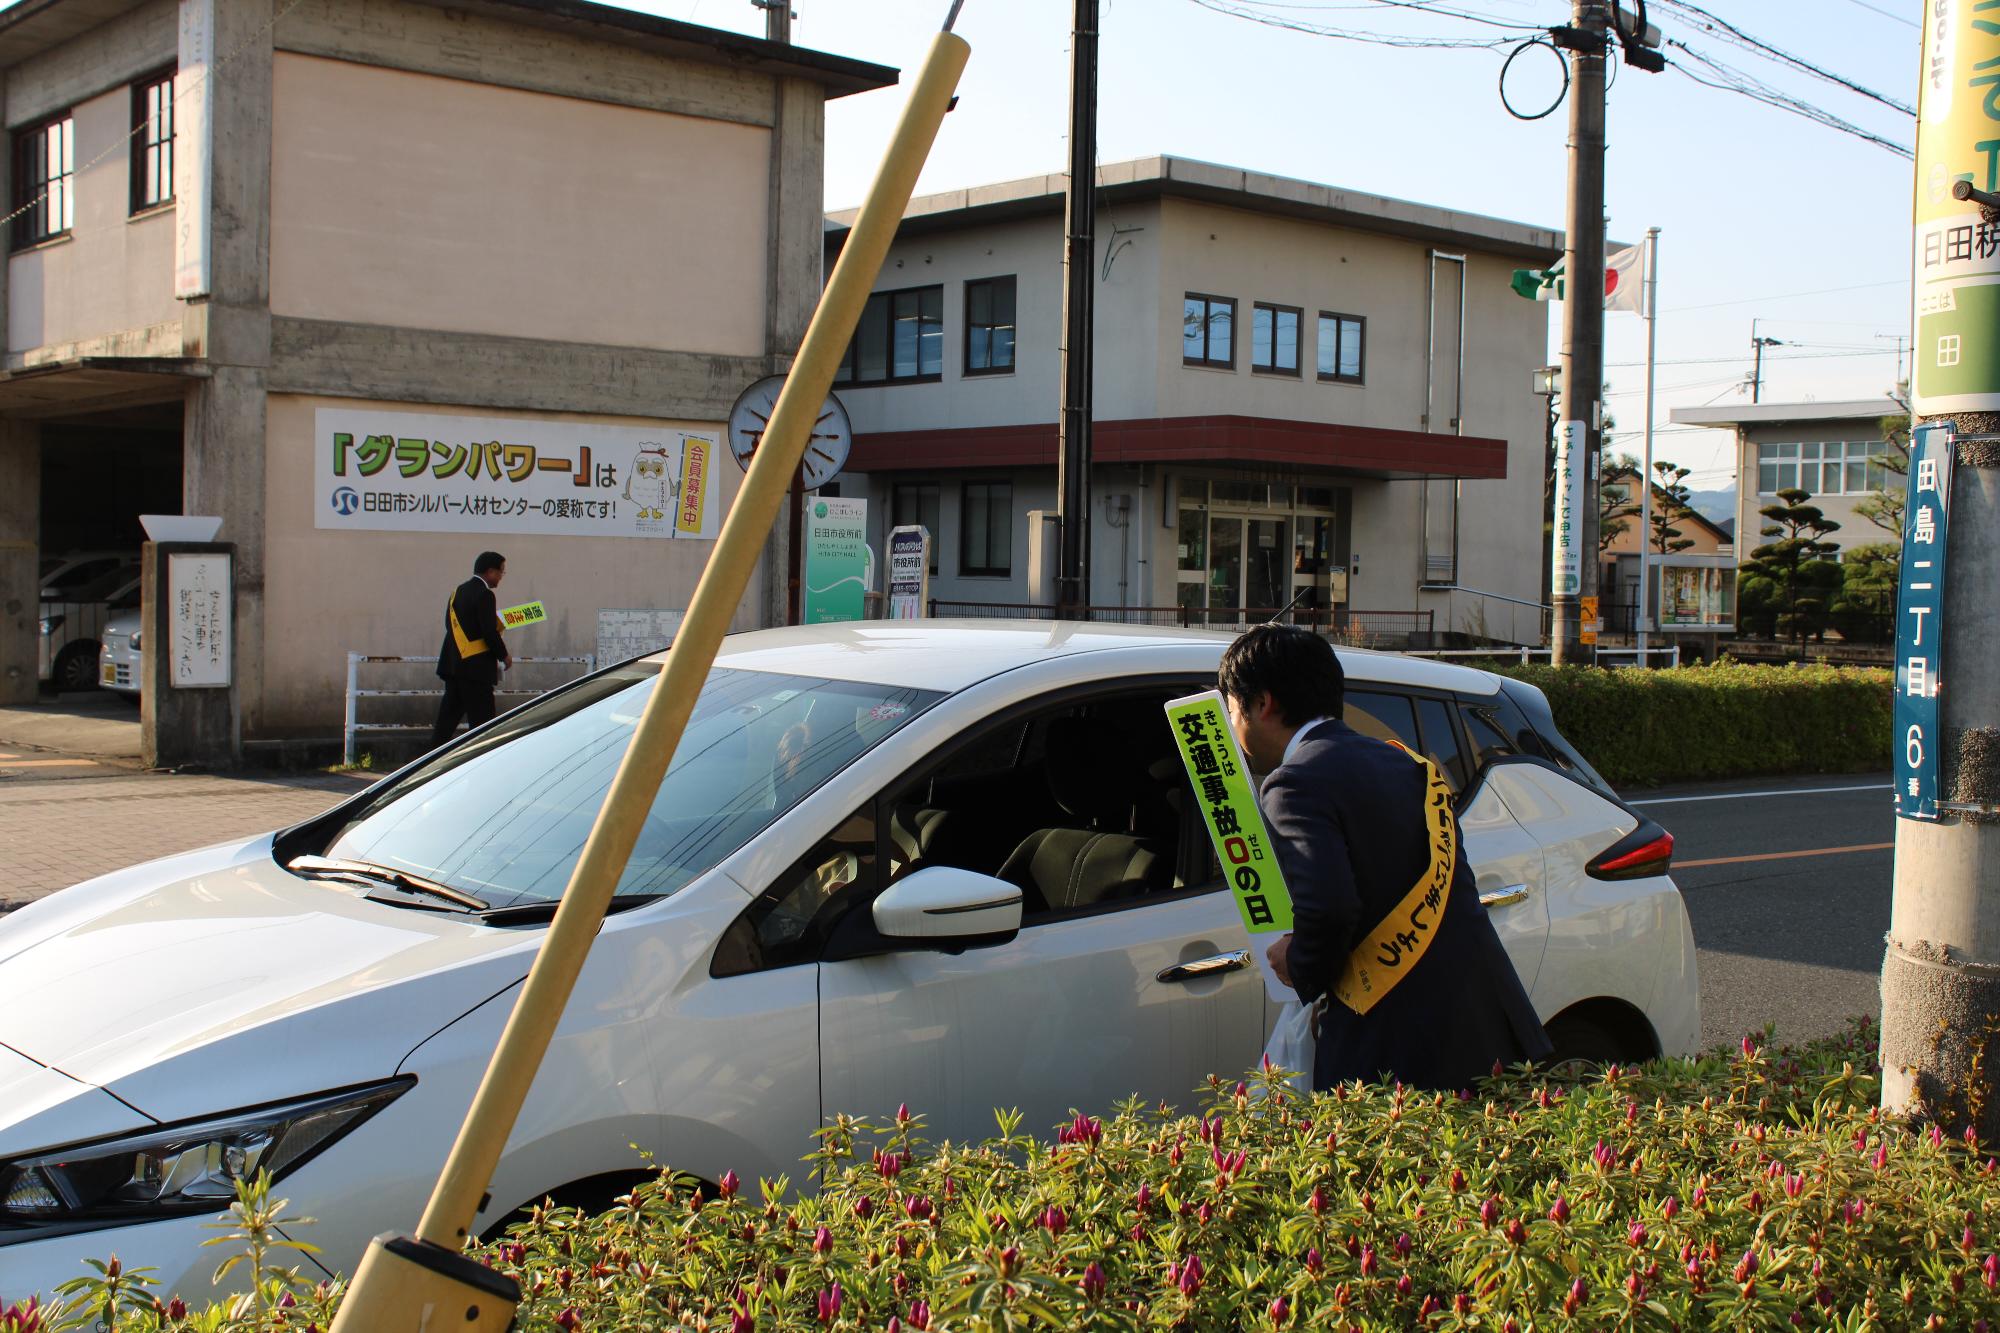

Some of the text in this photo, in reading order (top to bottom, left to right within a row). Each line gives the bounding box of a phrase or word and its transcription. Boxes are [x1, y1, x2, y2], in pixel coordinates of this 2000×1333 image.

[1921, 292, 1951, 311] ここは
[684, 445, 704, 526] 会員募集中
[814, 527, 862, 539] 日田市役所前
[893, 557, 921, 568] 市役所前
[1203, 709, 1236, 777] きょうは
[1247, 834, 1264, 861] ゼロ
